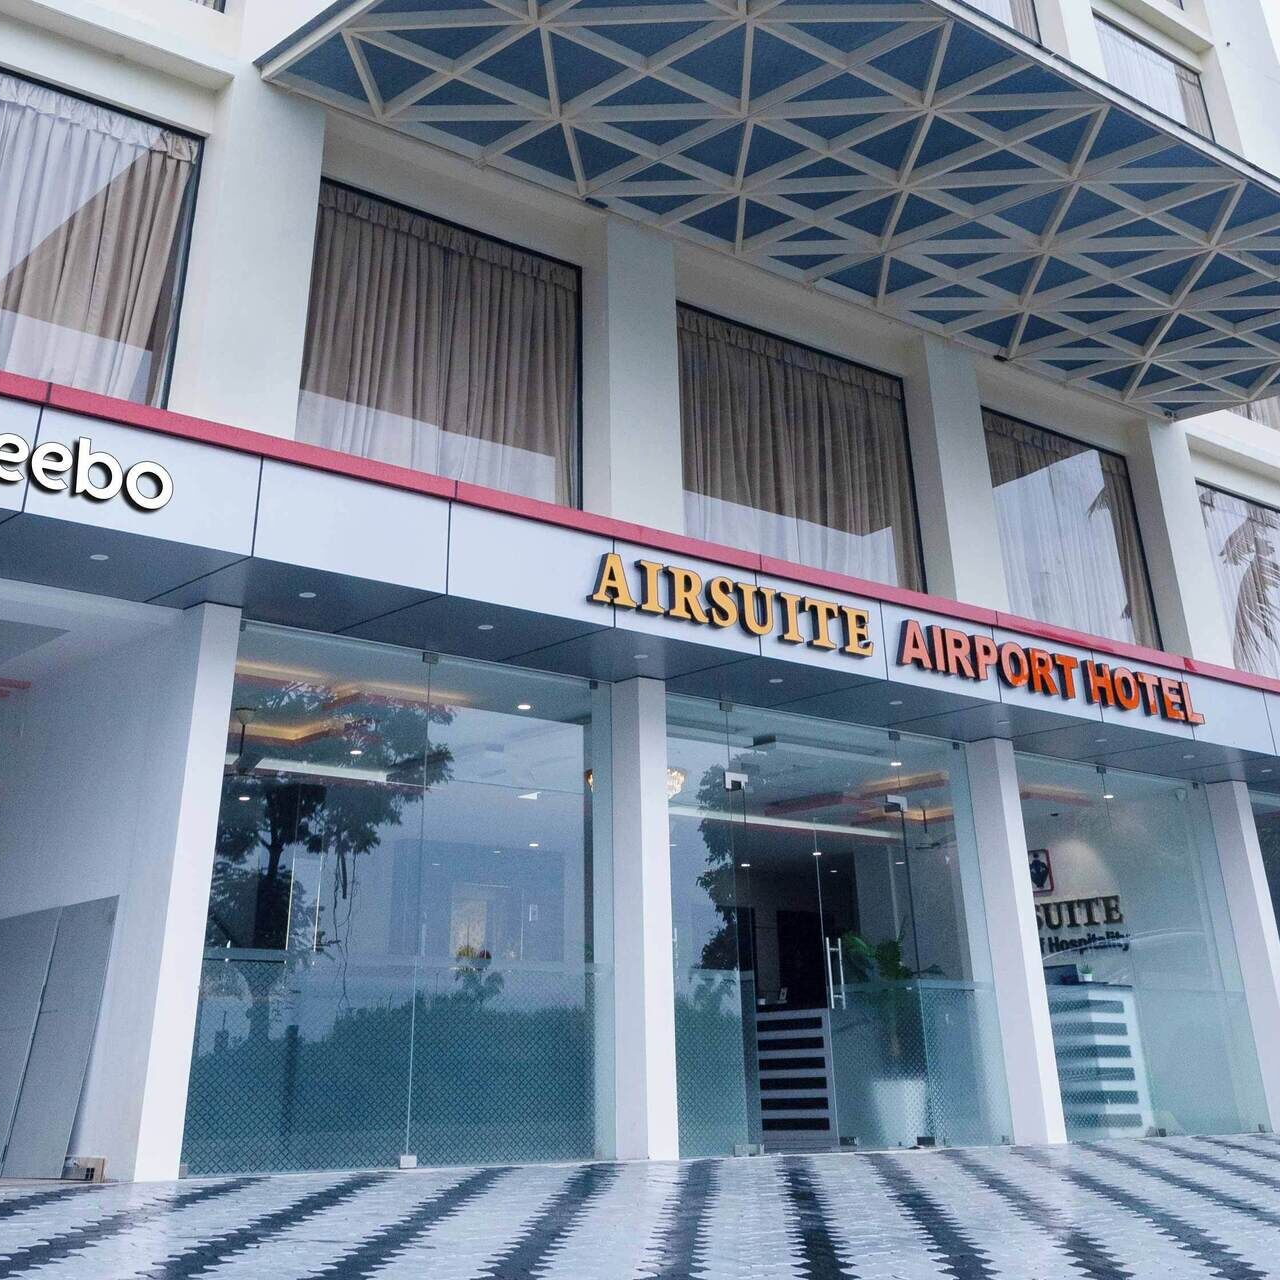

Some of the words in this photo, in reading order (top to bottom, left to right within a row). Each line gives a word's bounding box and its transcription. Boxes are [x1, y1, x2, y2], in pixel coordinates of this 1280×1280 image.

[587, 552, 874, 657] AIRSUITE
[897, 619, 1077, 700] AIRPORT
[1081, 659, 1205, 725] HOTEL
